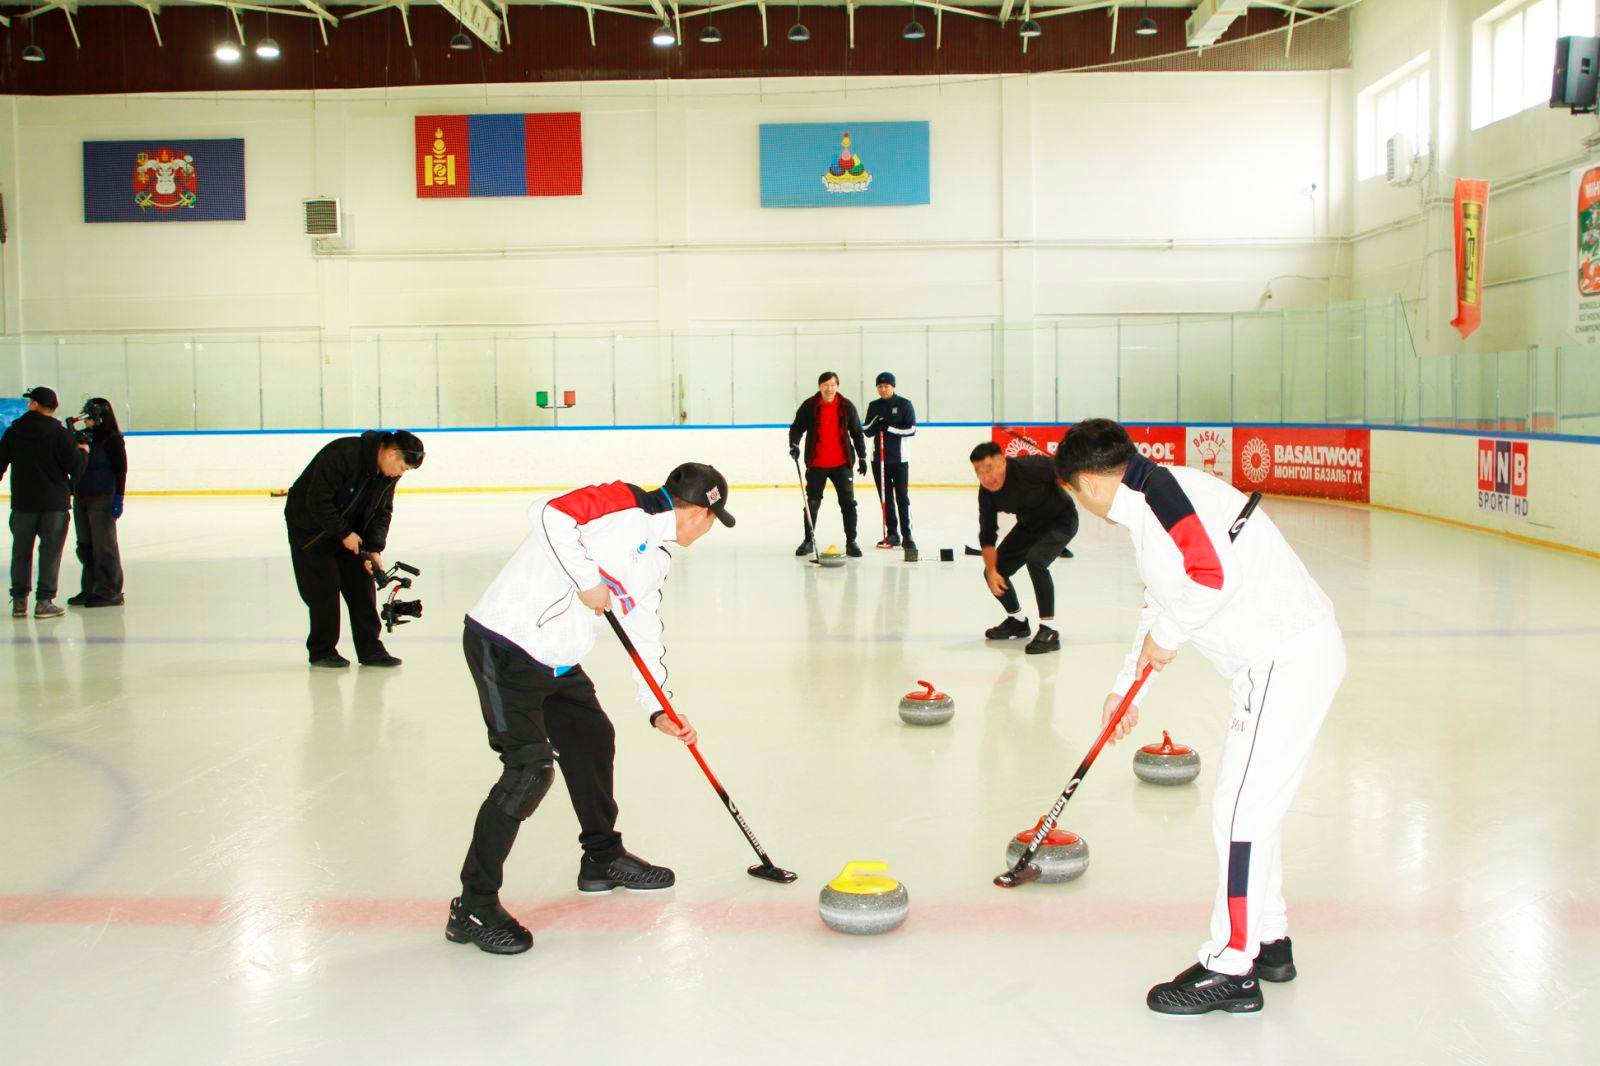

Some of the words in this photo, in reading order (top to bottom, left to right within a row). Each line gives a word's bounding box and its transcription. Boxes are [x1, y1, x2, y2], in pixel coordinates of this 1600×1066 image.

[1193, 431, 1226, 448] BASALT
[1274, 445, 1363, 468] BASALTWOOL
[1480, 450, 1526, 486] MNB
[1274, 466, 1312, 480] МОНГОЛ
[1314, 468, 1352, 484] БАЗАЛЬТ
[1353, 470, 1363, 484] ХК
[1478, 491, 1509, 513] SPORT
[1514, 497, 1528, 517] HD
